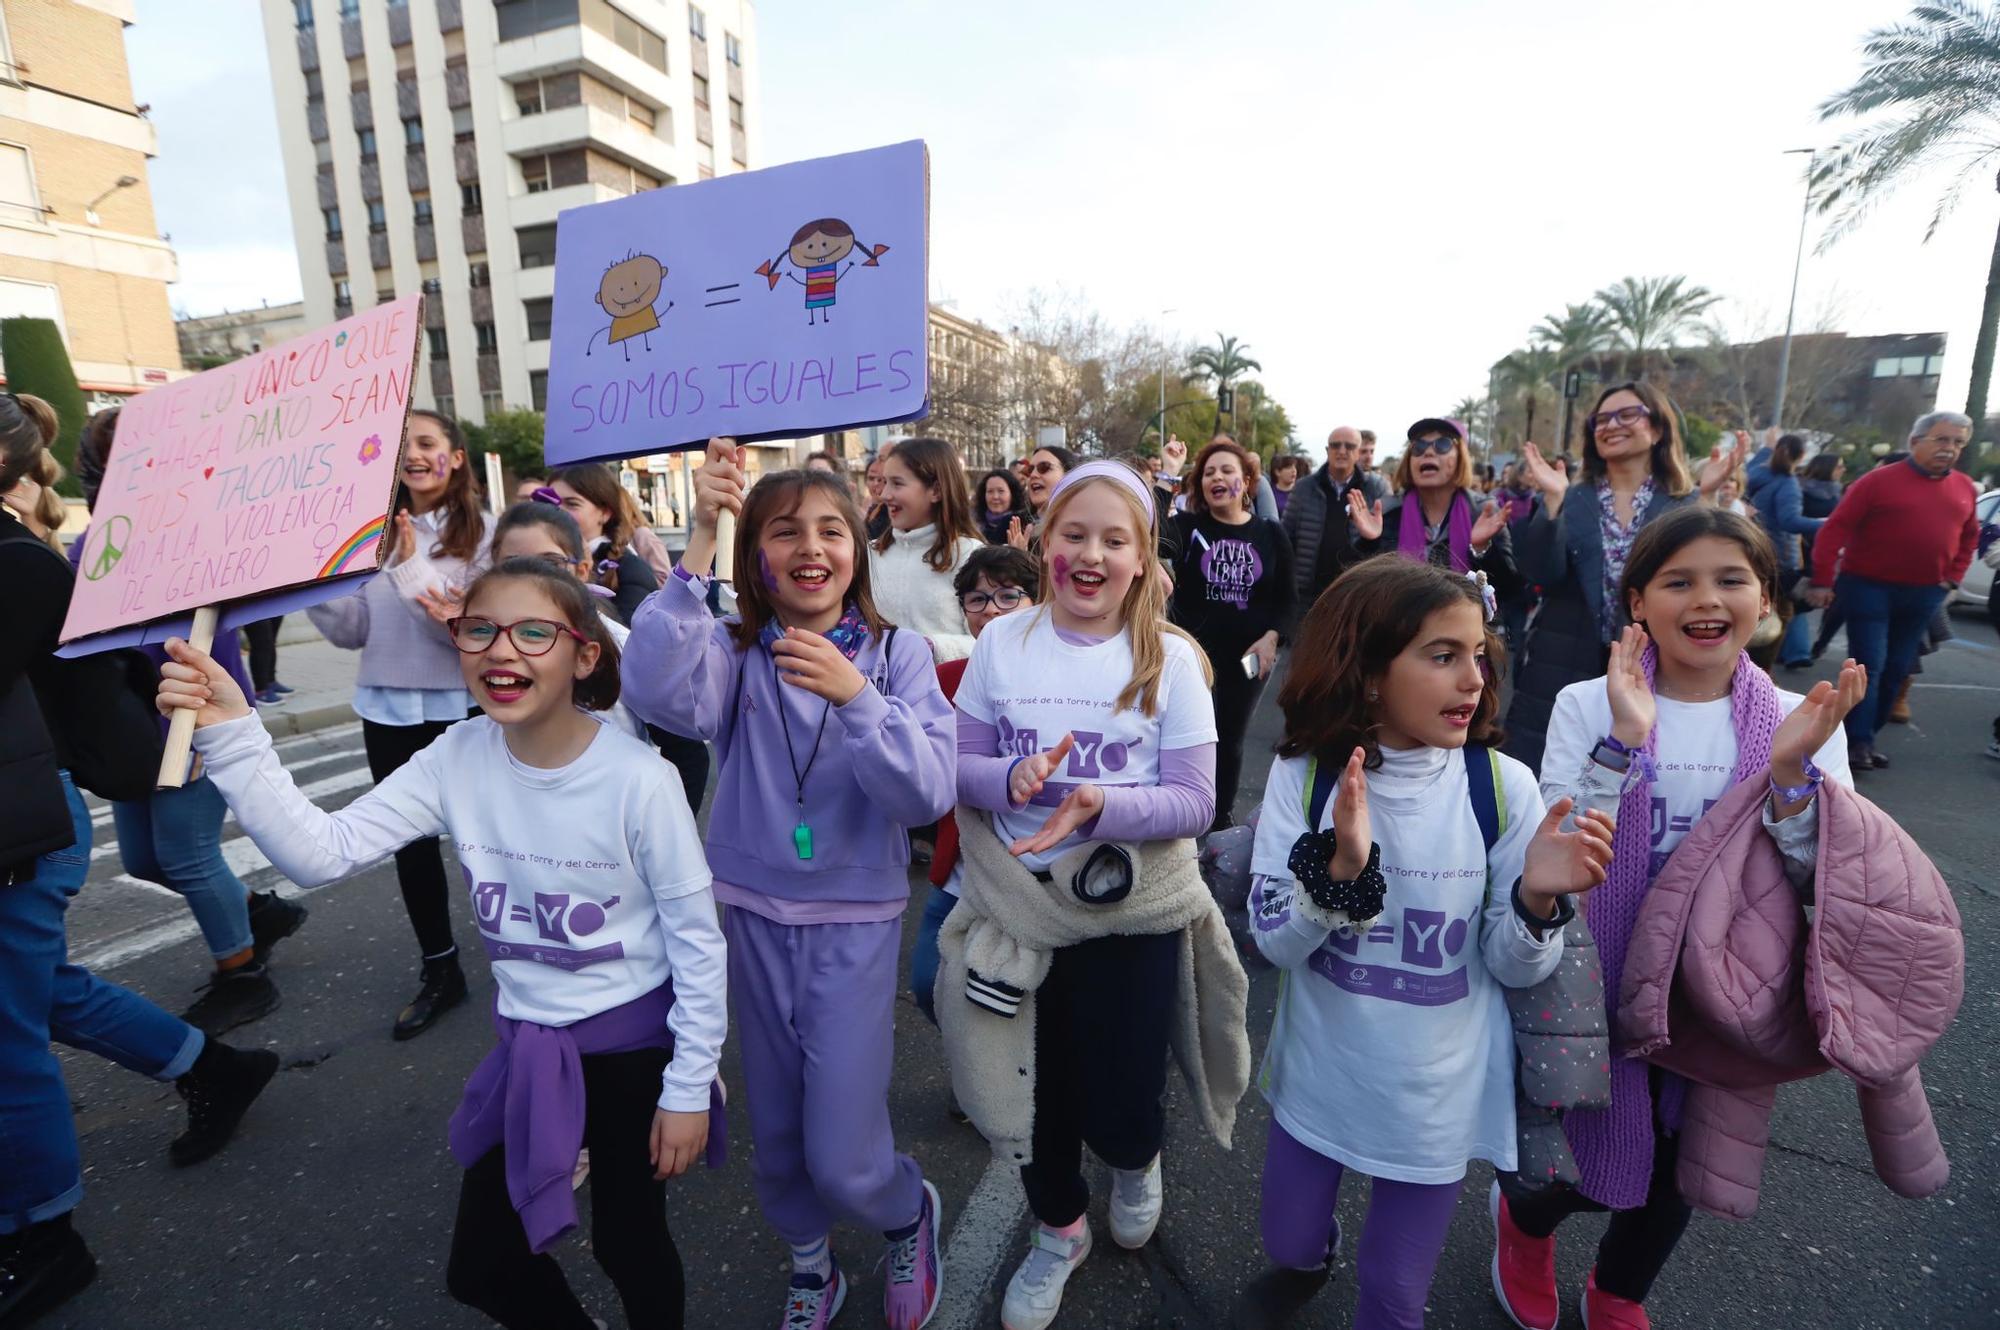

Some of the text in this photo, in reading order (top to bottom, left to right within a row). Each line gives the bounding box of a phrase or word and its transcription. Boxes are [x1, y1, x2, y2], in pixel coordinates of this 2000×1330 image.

[121, 388, 191, 446] QUE
[199, 374, 236, 418] LO
[344, 311, 404, 369] QUE
[571, 350, 914, 434] SOMOS IGUALES
[117, 446, 151, 491] TE
[153, 424, 223, 483] HAGA
[320, 362, 409, 431] SEAN
[132, 443, 336, 537] TUS TACONES
[119, 540, 146, 576] NO
[151, 533, 167, 568] A
[1211, 540, 1254, 564] VIVAS
[120, 544, 271, 615] DE GENERO
[1207, 561, 1255, 587] LIBRES
[1205, 583, 1252, 602] IGUALES
[1066, 697, 1091, 706] Torre
[1093, 701, 1100, 709] y
[1666, 763, 1680, 771] de
[1684, 763, 1695, 771] la
[1729, 766, 1737, 775] y
[504, 851, 515, 860] de
[516, 852, 526, 861] la
[529, 854, 554, 866] Torre
[556, 860, 563, 869] y
[565, 860, 582, 868] del
[1381, 864, 1393, 873] la
[1395, 867, 1428, 879] Torre
[1431, 872, 1439, 881] y
